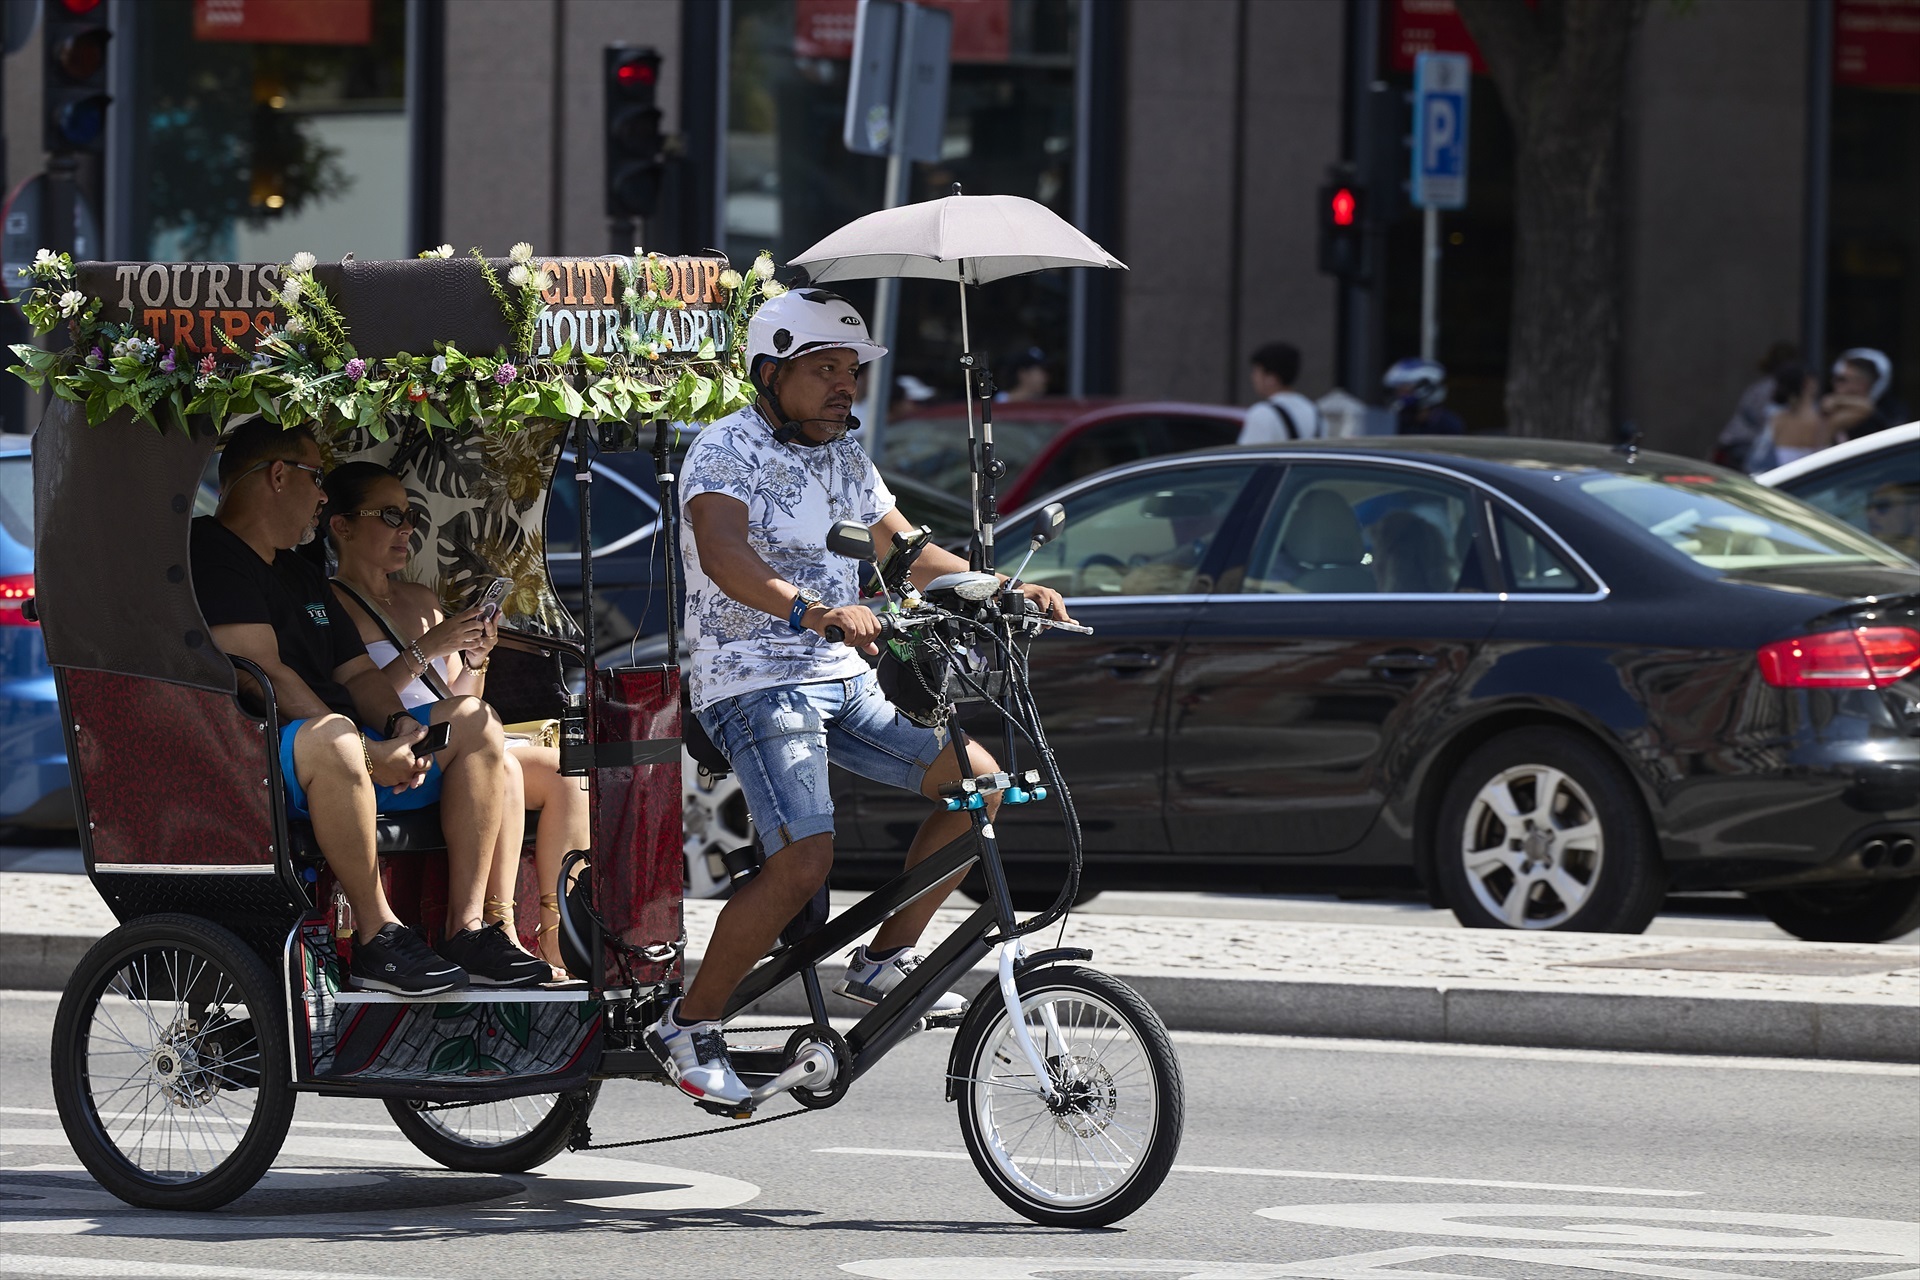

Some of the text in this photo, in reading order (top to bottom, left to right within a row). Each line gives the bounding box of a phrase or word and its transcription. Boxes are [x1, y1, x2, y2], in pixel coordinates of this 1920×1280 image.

[1427, 98, 1456, 168] P
[116, 264, 287, 308] TOURIS
[541, 261, 616, 305] CITY
[536, 309, 624, 355] TOUR
